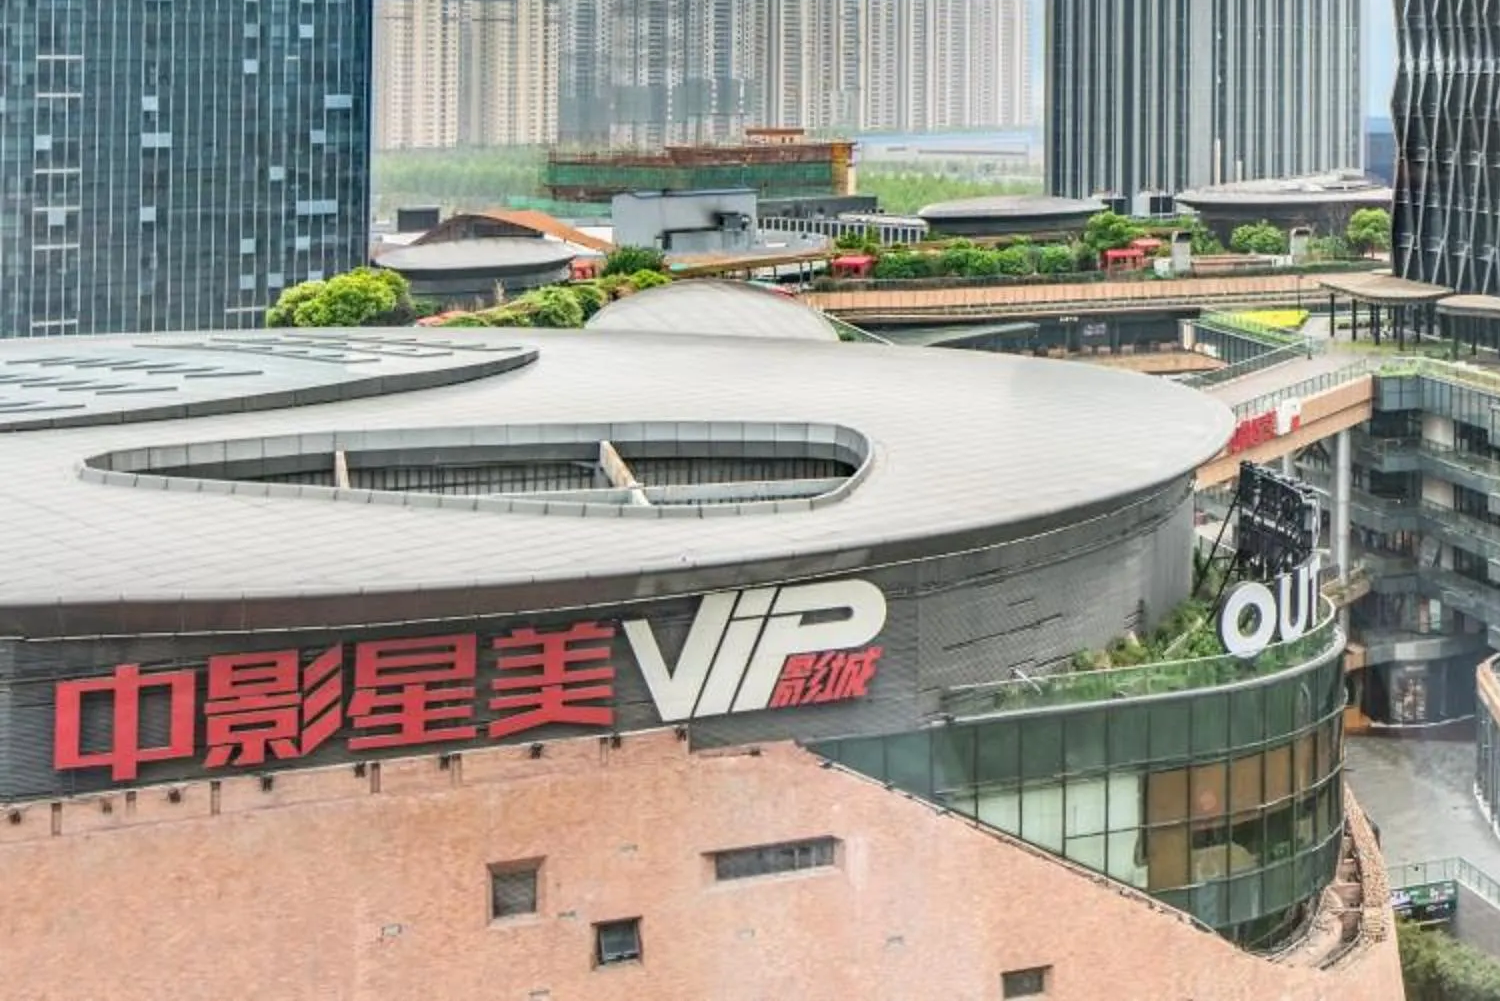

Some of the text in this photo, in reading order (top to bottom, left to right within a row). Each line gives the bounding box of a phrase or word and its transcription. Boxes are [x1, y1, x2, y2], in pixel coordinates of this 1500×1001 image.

[54, 620, 618, 781] 中影星美
[767, 645, 884, 709] 影城
